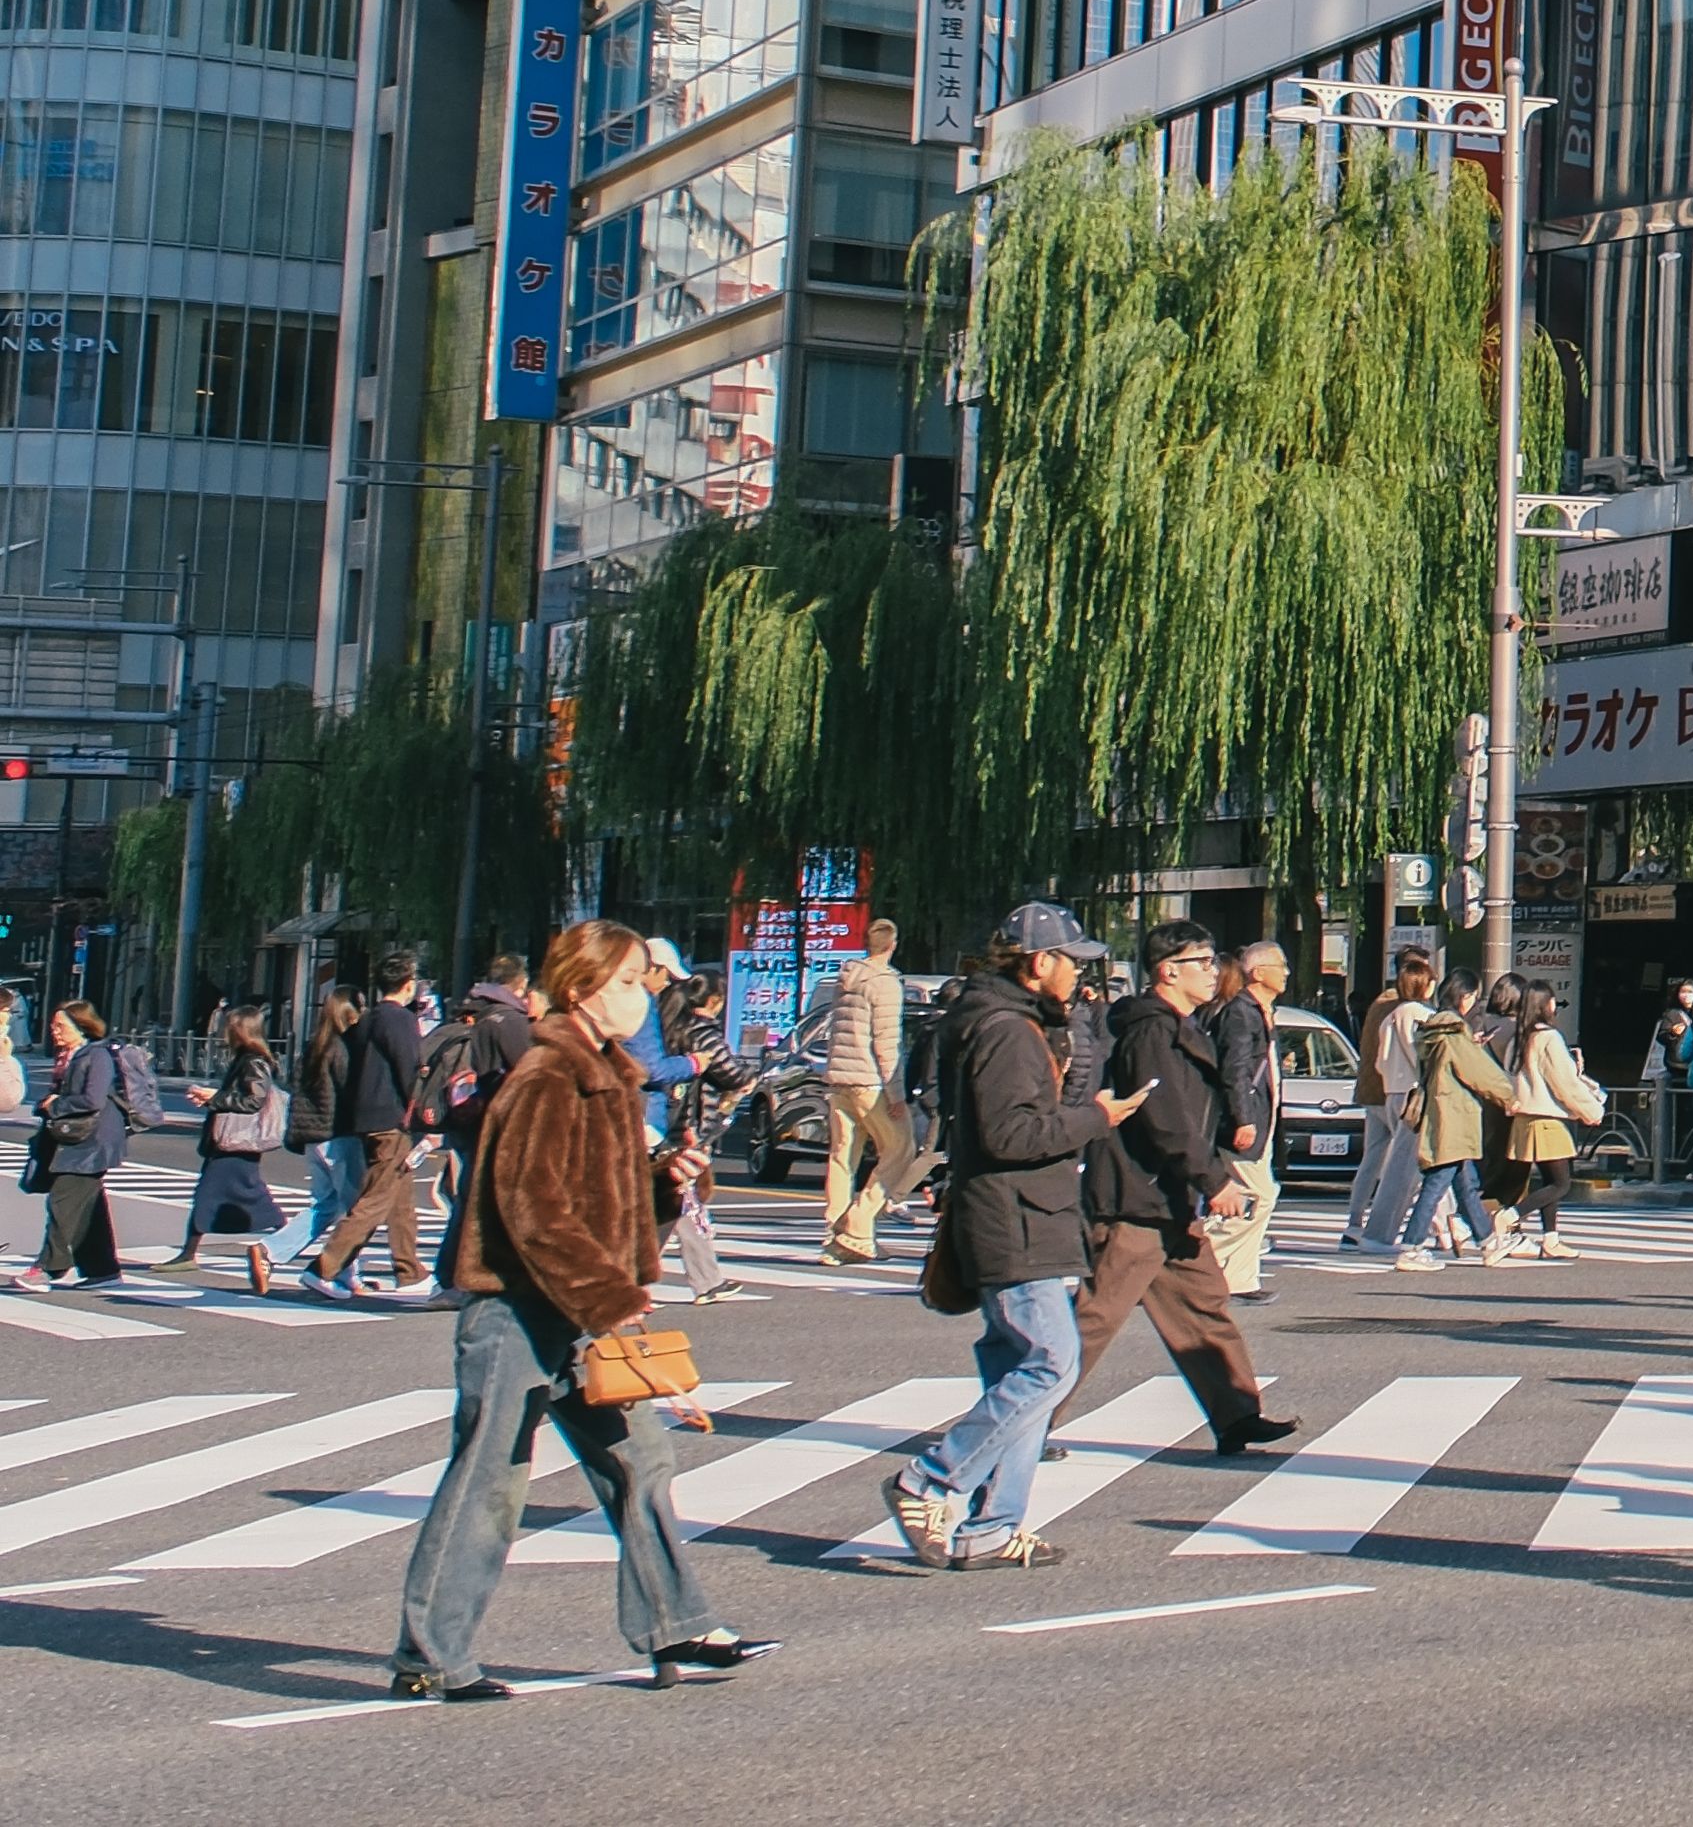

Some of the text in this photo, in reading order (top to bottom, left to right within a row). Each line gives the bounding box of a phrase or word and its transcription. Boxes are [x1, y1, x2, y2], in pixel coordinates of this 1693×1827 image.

[1456, 58, 1500, 153] BG
[511, 26, 567, 373] カラオケ館
[1558, 556, 1663, 616] 銀座珈琲店
[1515, 938, 1573, 953] ダーツバー
[1515, 954, 1573, 967] B-GARAGE
